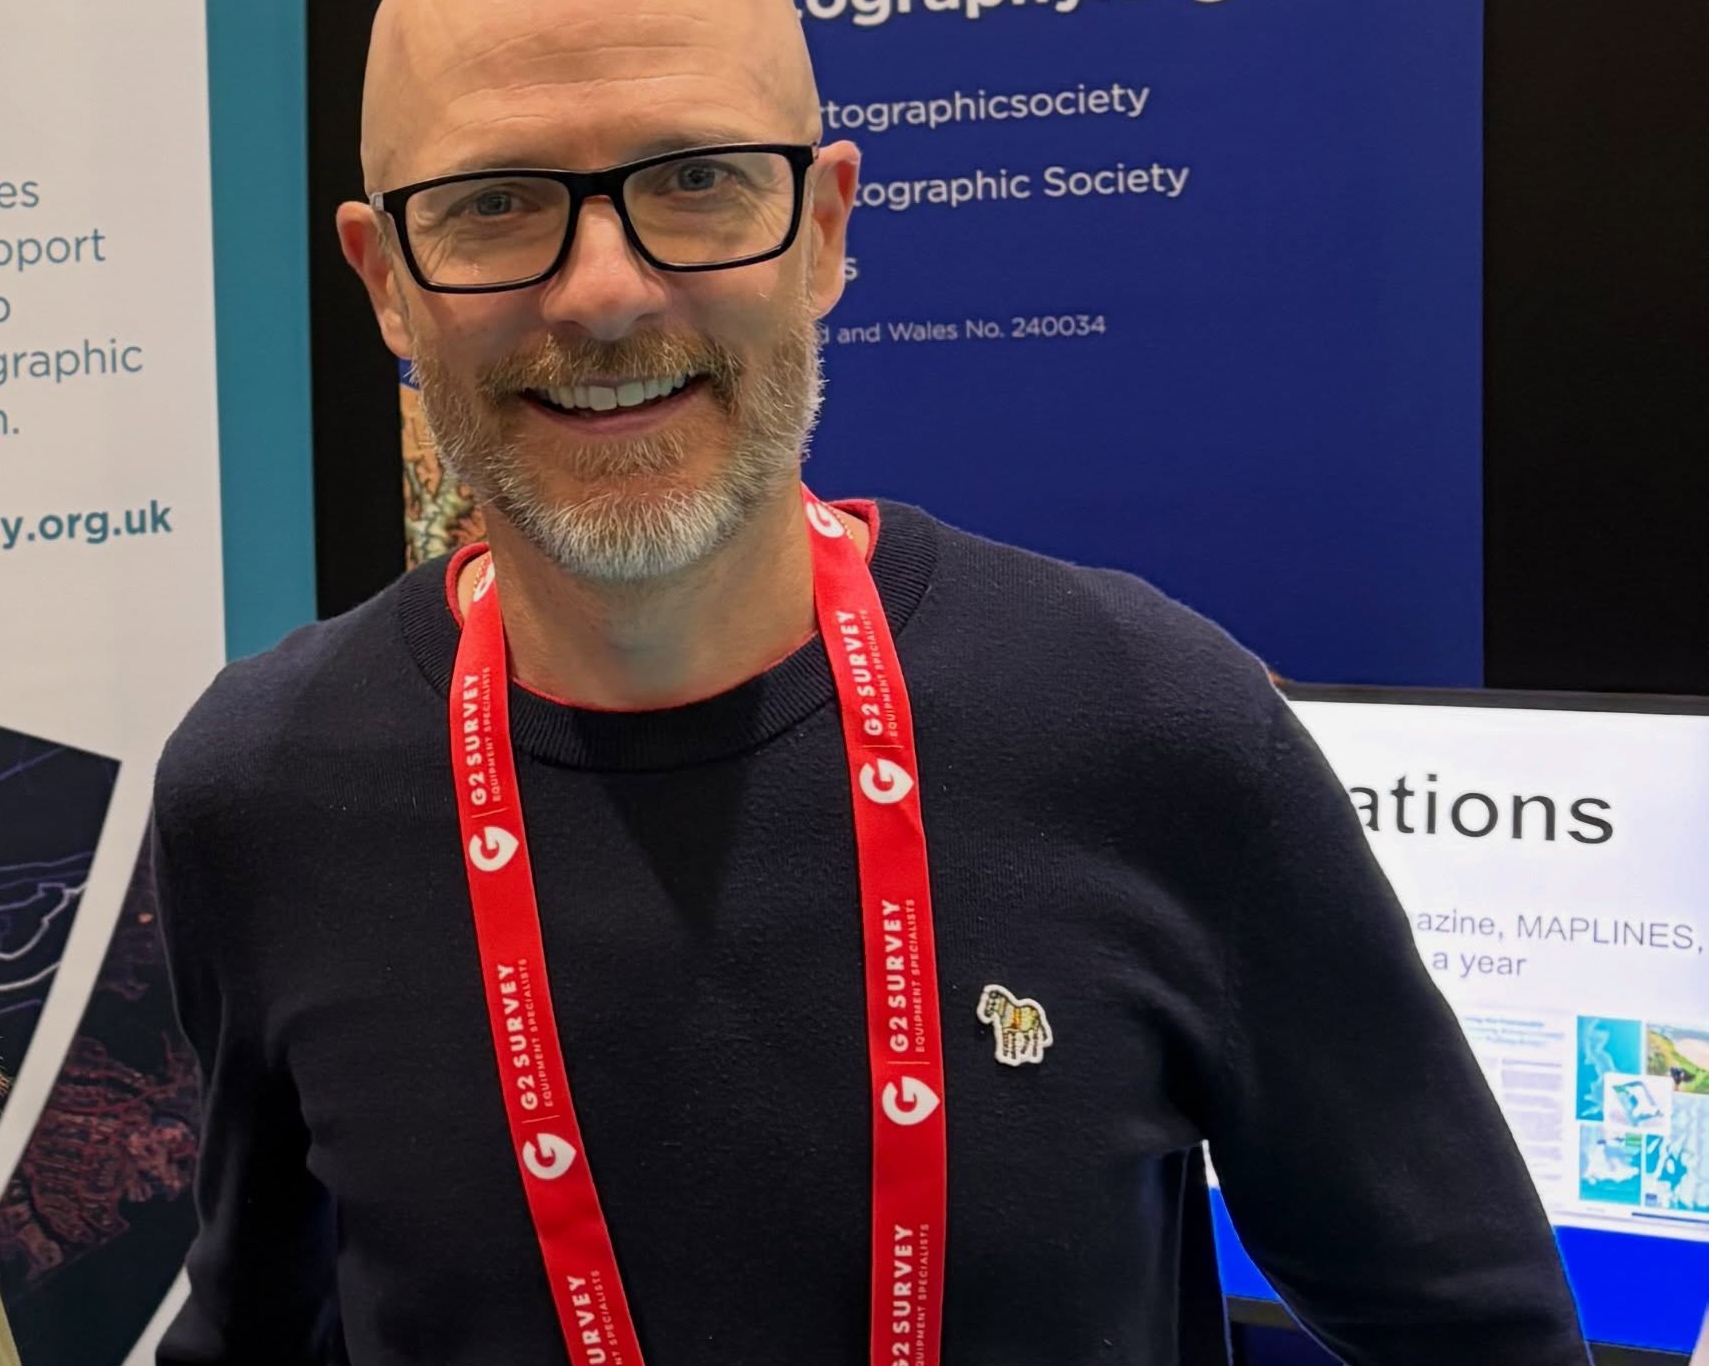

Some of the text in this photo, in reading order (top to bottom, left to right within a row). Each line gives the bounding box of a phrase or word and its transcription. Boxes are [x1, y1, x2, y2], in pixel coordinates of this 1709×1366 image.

[1043, 162, 1190, 198] Society
[837, 315, 1108, 344] and Wales No. 240034
[836, 609, 885, 737] G2 SURVEY
[463, 674, 488, 806] G2 SURVEY
[1350, 773, 1615, 846] ations
[1416, 909, 1705, 955] azine, MAPLINES,
[1432, 951, 1529, 980] a year
[882, 900, 910, 1054] G2 SURVEY
[905, 898, 926, 1054] EQUIPMENT SPECIALISTS
[497, 964, 539, 1111] G2 SURVEY
[891, 1225, 916, 1334] SURVEY
[916, 1222, 931, 1301] SPECIALISTS
[590, 1269, 620, 1348] SPECIALISTS
